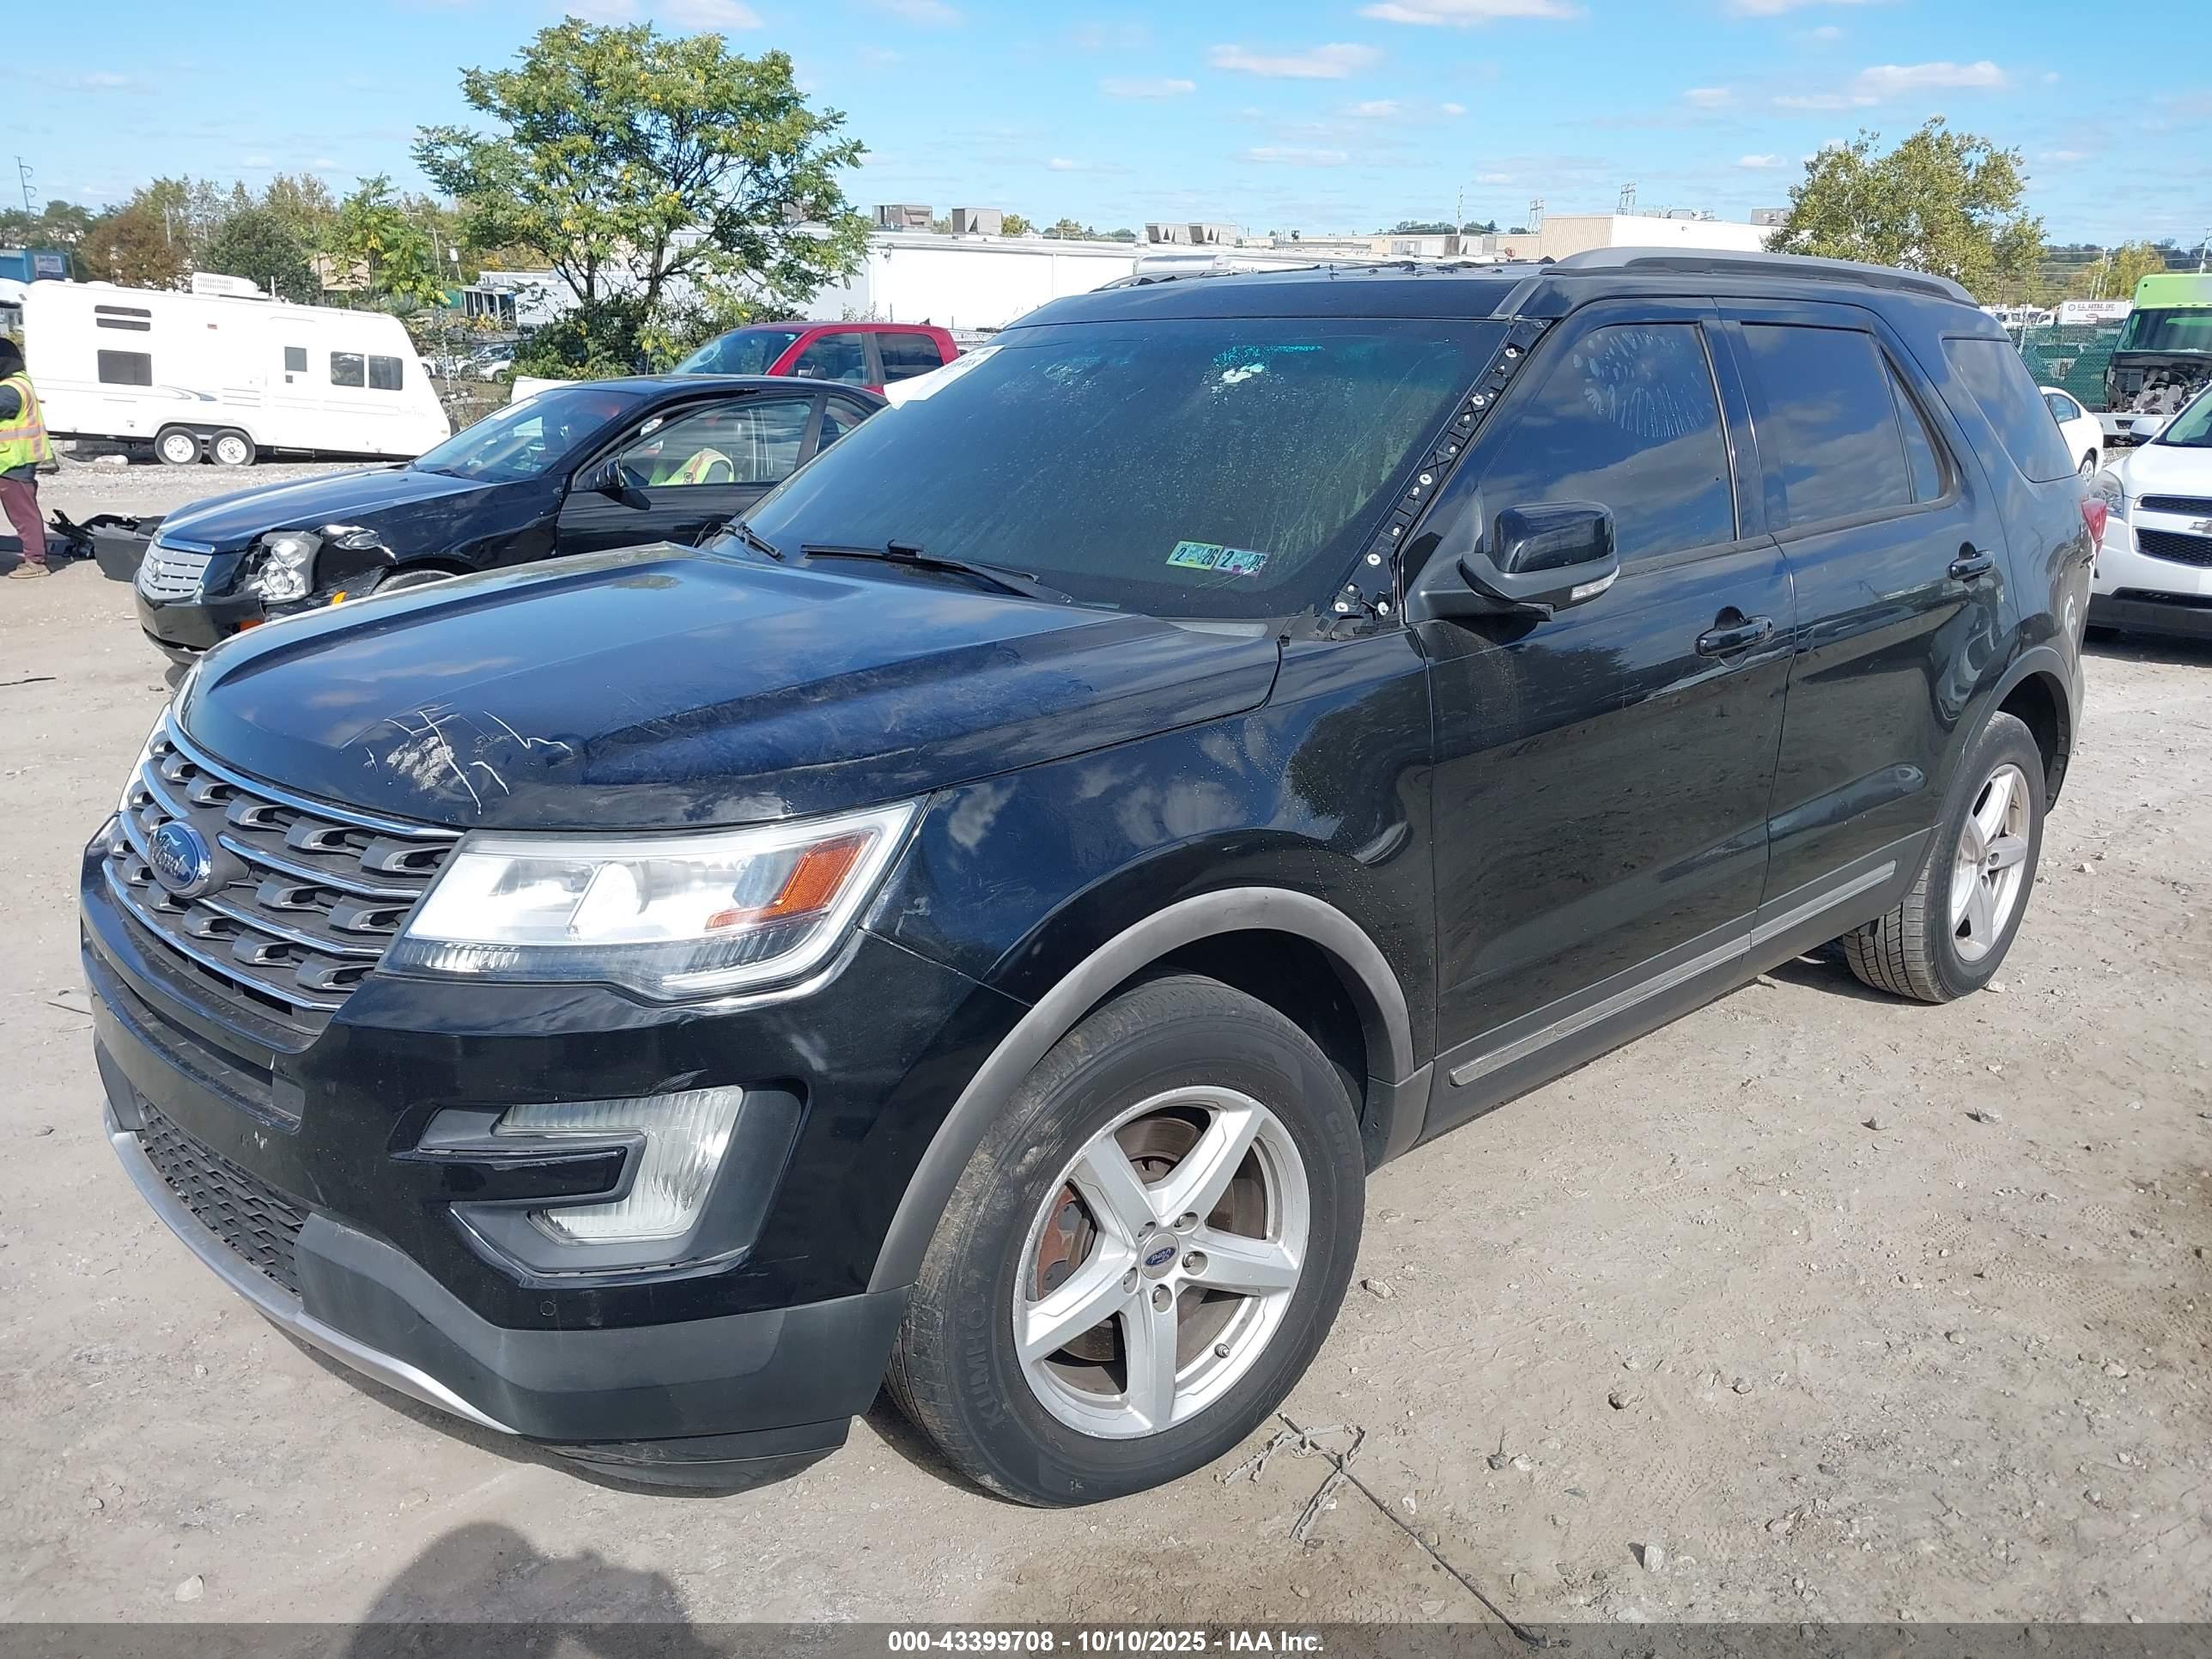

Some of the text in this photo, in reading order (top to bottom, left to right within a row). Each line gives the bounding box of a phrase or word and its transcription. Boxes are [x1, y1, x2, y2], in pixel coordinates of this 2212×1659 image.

[1175, 548, 1218, 565] 2 26
[1221, 550, 1234, 568] 2
[151, 832, 186, 878] Ford
[1151, 1248, 1171, 1265] Ford
[967, 1308, 1005, 1427] KUMHO
